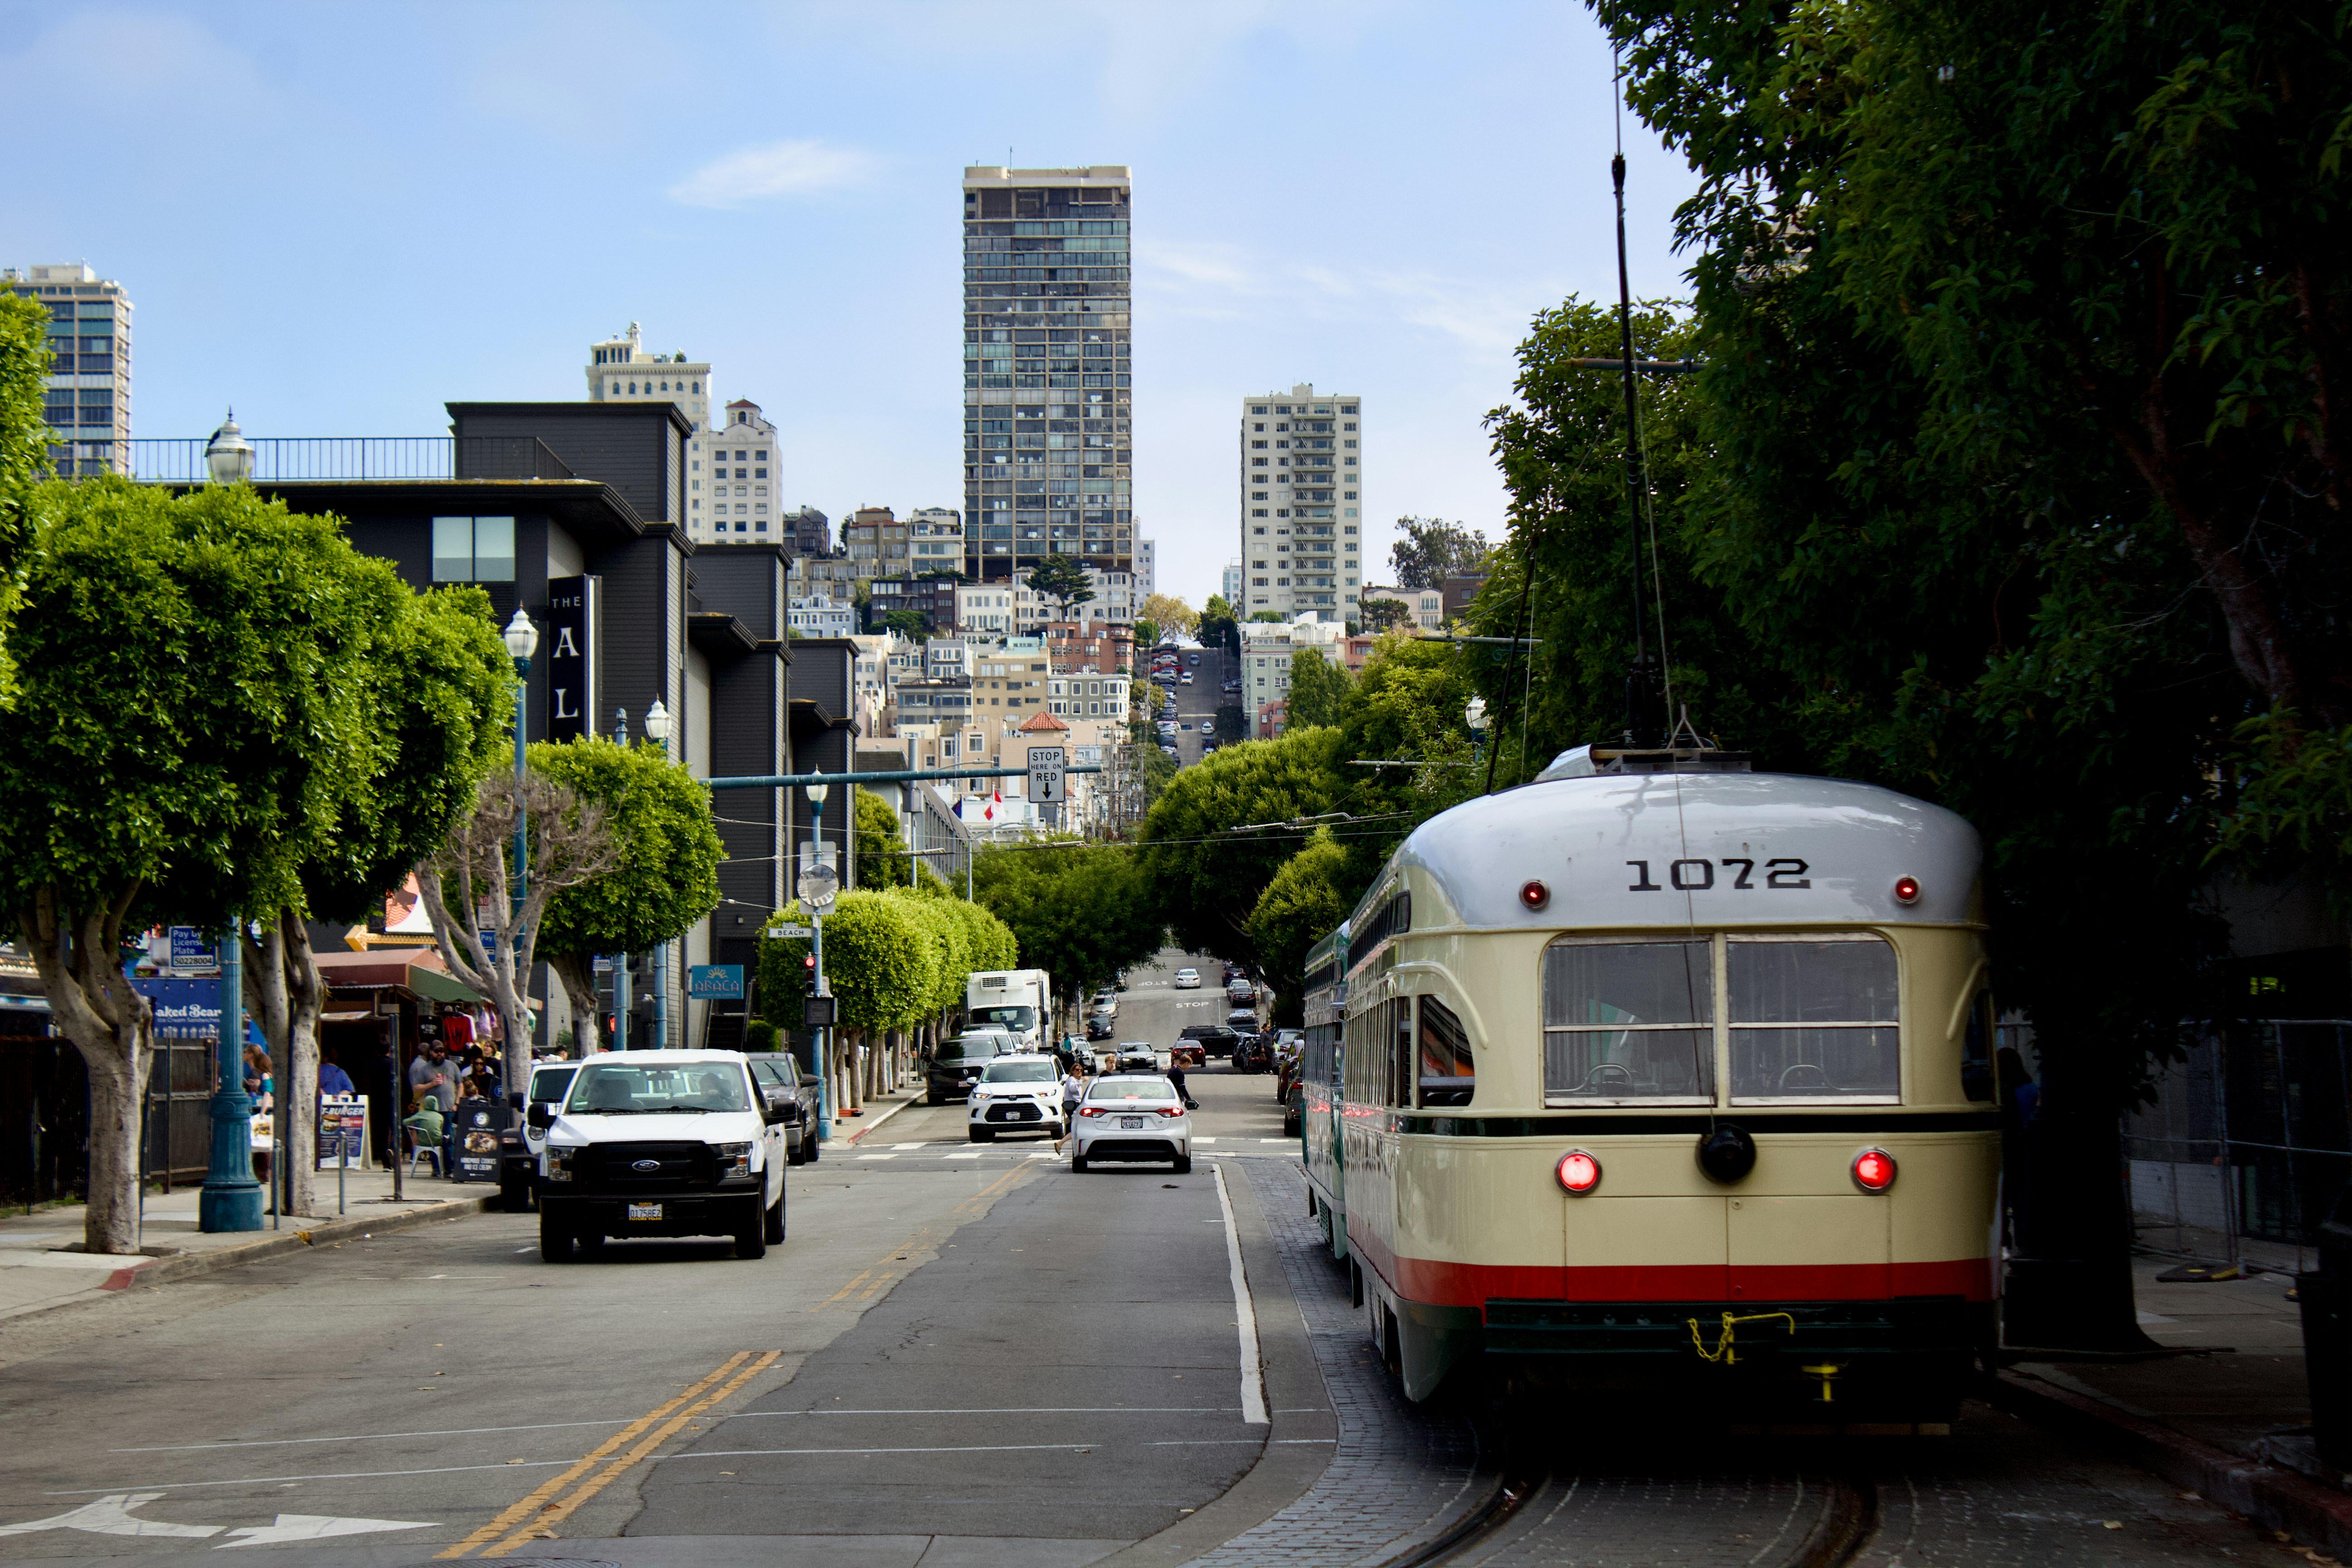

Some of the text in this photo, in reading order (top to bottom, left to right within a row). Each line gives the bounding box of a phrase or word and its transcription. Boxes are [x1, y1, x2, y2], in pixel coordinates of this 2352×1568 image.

[552, 596, 581, 608] THE
[1032, 752, 1060, 761] STOP
[1036, 772, 1057, 782] RED
[1626, 858, 1811, 891] 1072
[174, 930, 189, 939] Pay
[695, 980, 739, 992] ABACA
[156, 1004, 222, 1018] aked Bear
[630, 1209, 661, 1218] 01758E2
